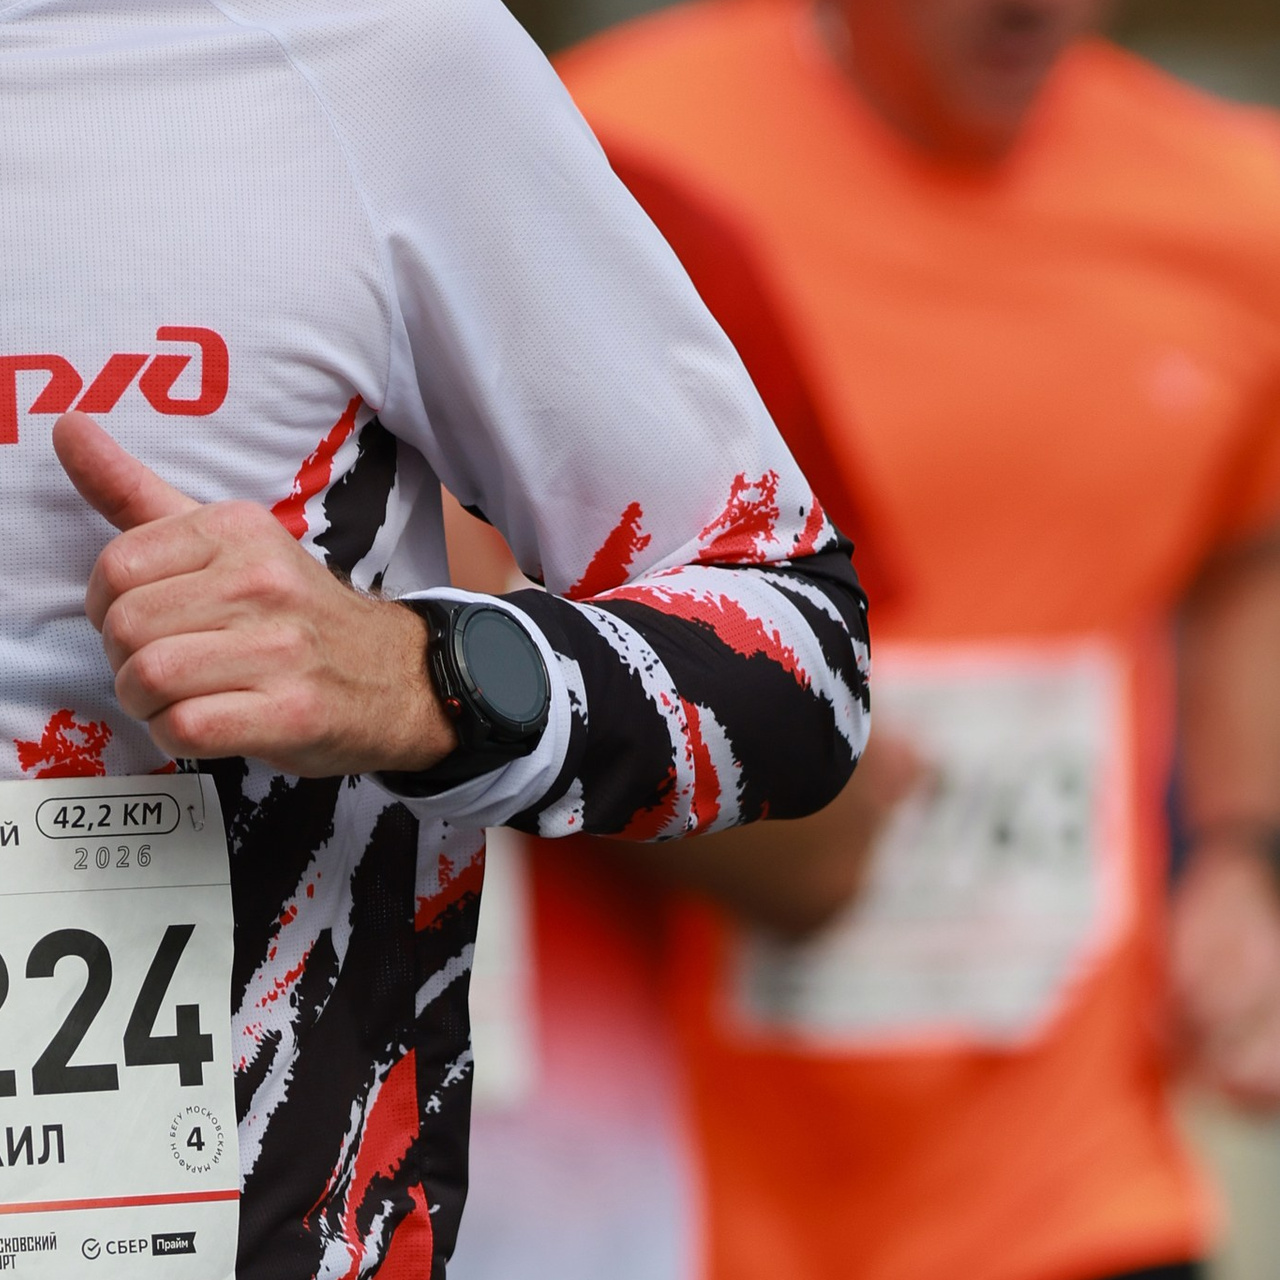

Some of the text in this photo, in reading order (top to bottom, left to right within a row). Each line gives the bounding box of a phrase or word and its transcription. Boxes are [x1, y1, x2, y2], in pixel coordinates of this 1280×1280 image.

[52, 802, 163, 832] 42,2 КМ
[73, 844, 152, 871] 2026
[185, 1105, 225, 1164] МОСКОВСКИЙ
[186, 1126, 206, 1151] 4
[170, 1142, 211, 1174] МАРАФОН
[106, 1237, 189, 1255] СБЕР Прайм
